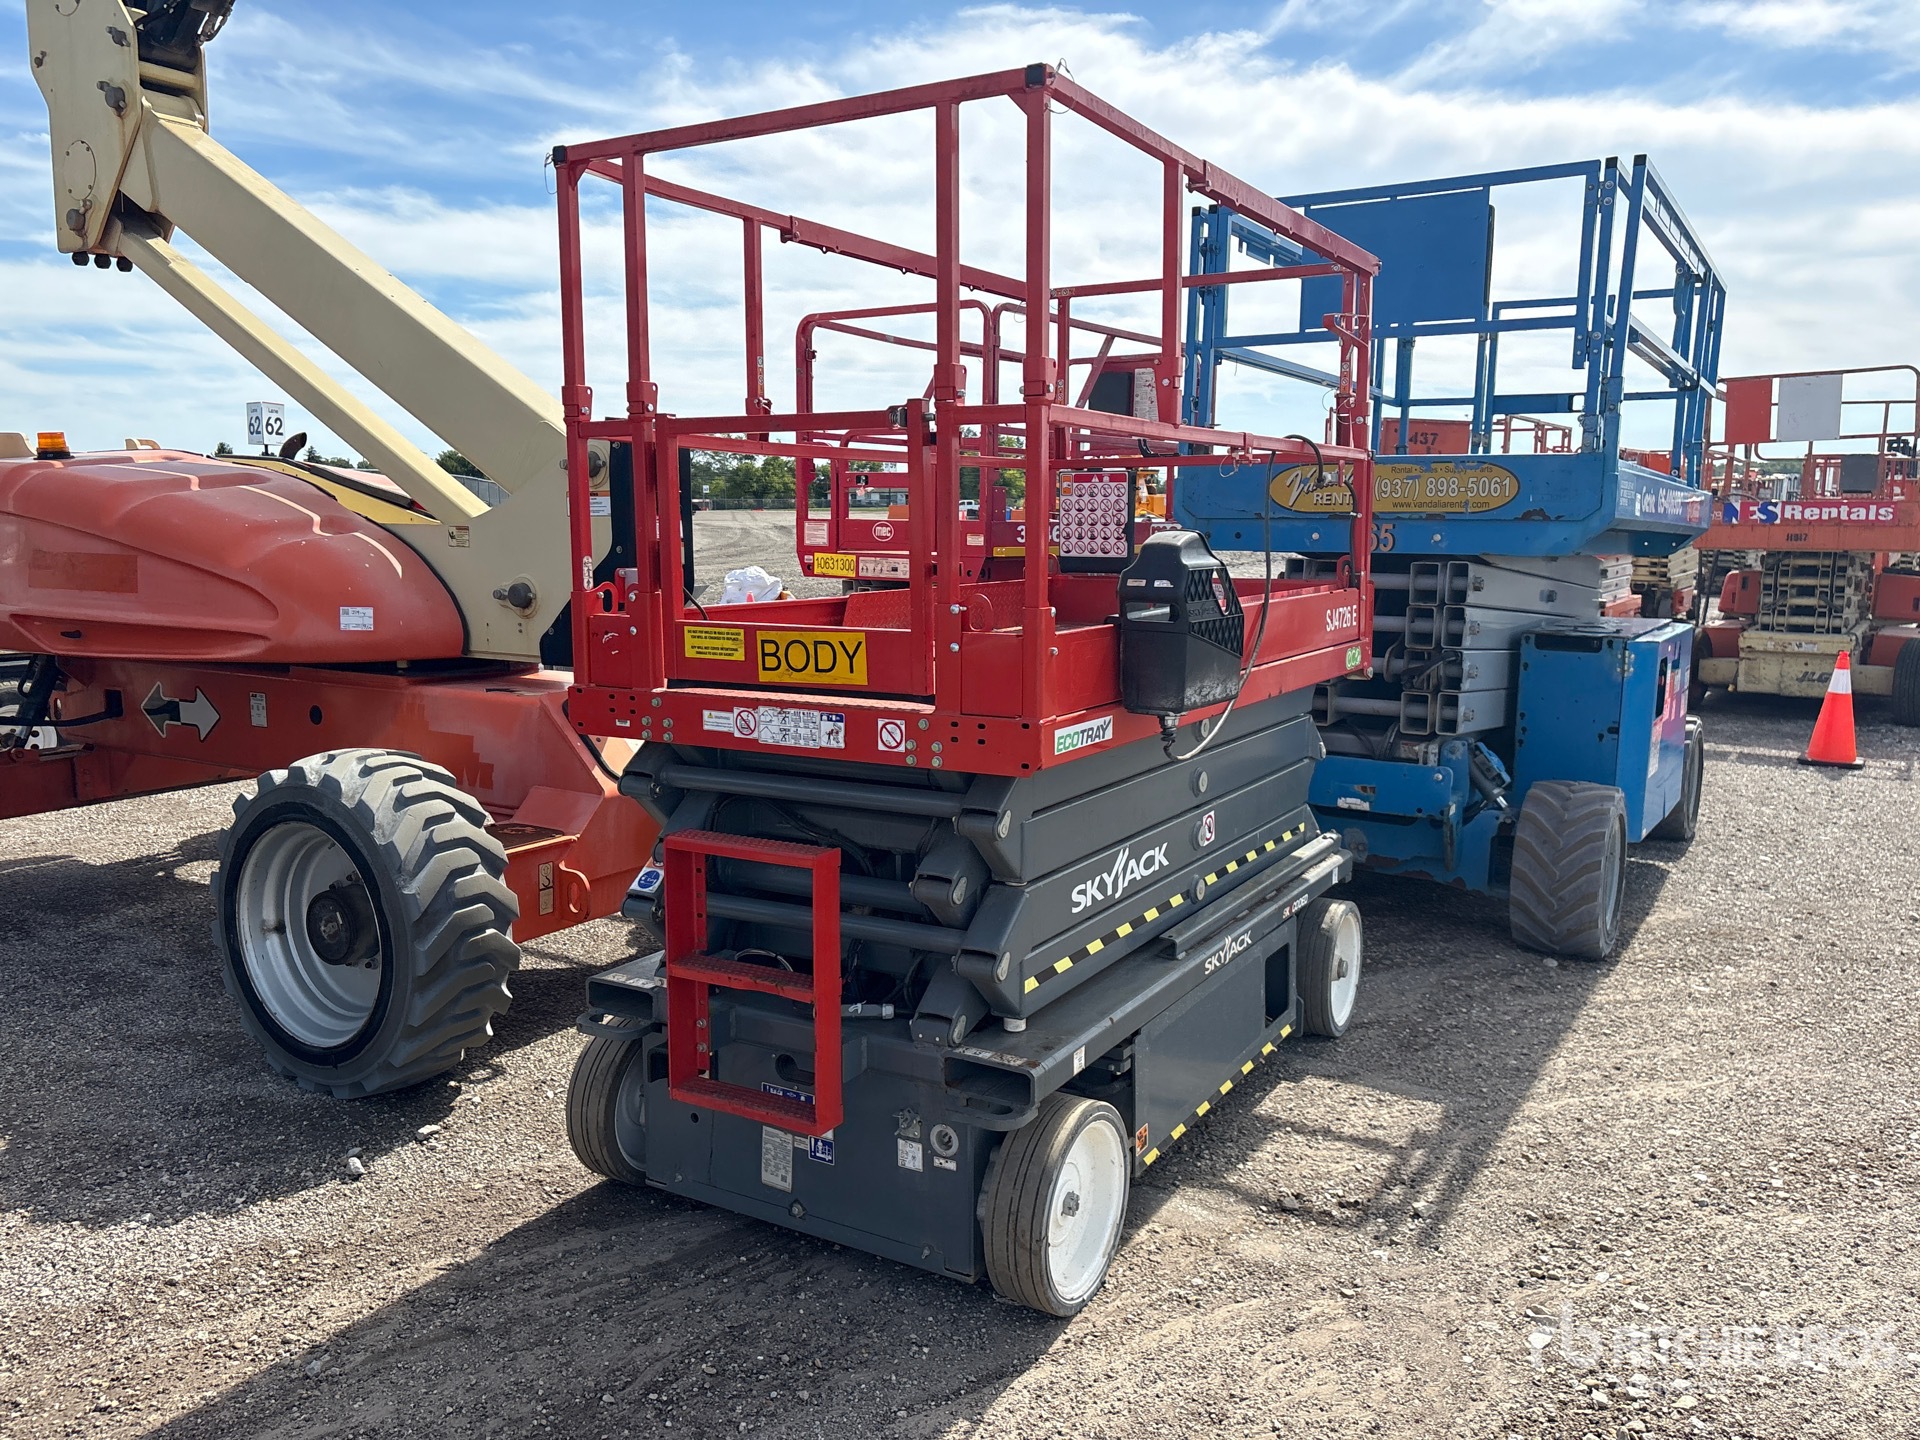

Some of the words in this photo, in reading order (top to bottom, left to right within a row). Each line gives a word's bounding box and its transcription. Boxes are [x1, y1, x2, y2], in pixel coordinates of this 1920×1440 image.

[248, 415, 262, 436] 62
[265, 416, 284, 436] 62
[1391, 466, 1413, 474] Rental
[1374, 476, 1420, 500] (937)
[1425, 476, 1511, 497] 898-5061
[1392, 500, 1490, 509] www.vandaliarent.com
[1784, 504, 1894, 521] Rentals
[1326, 606, 1351, 632] SJ4726
[1352, 604, 1357, 626] E
[760, 639, 863, 674] BODY
[1796, 671, 1833, 683] JLG
[1056, 717, 1112, 753] ECOTRAY
[1071, 842, 1170, 914] SKYJACK
[1204, 930, 1252, 975] SKYJACK
